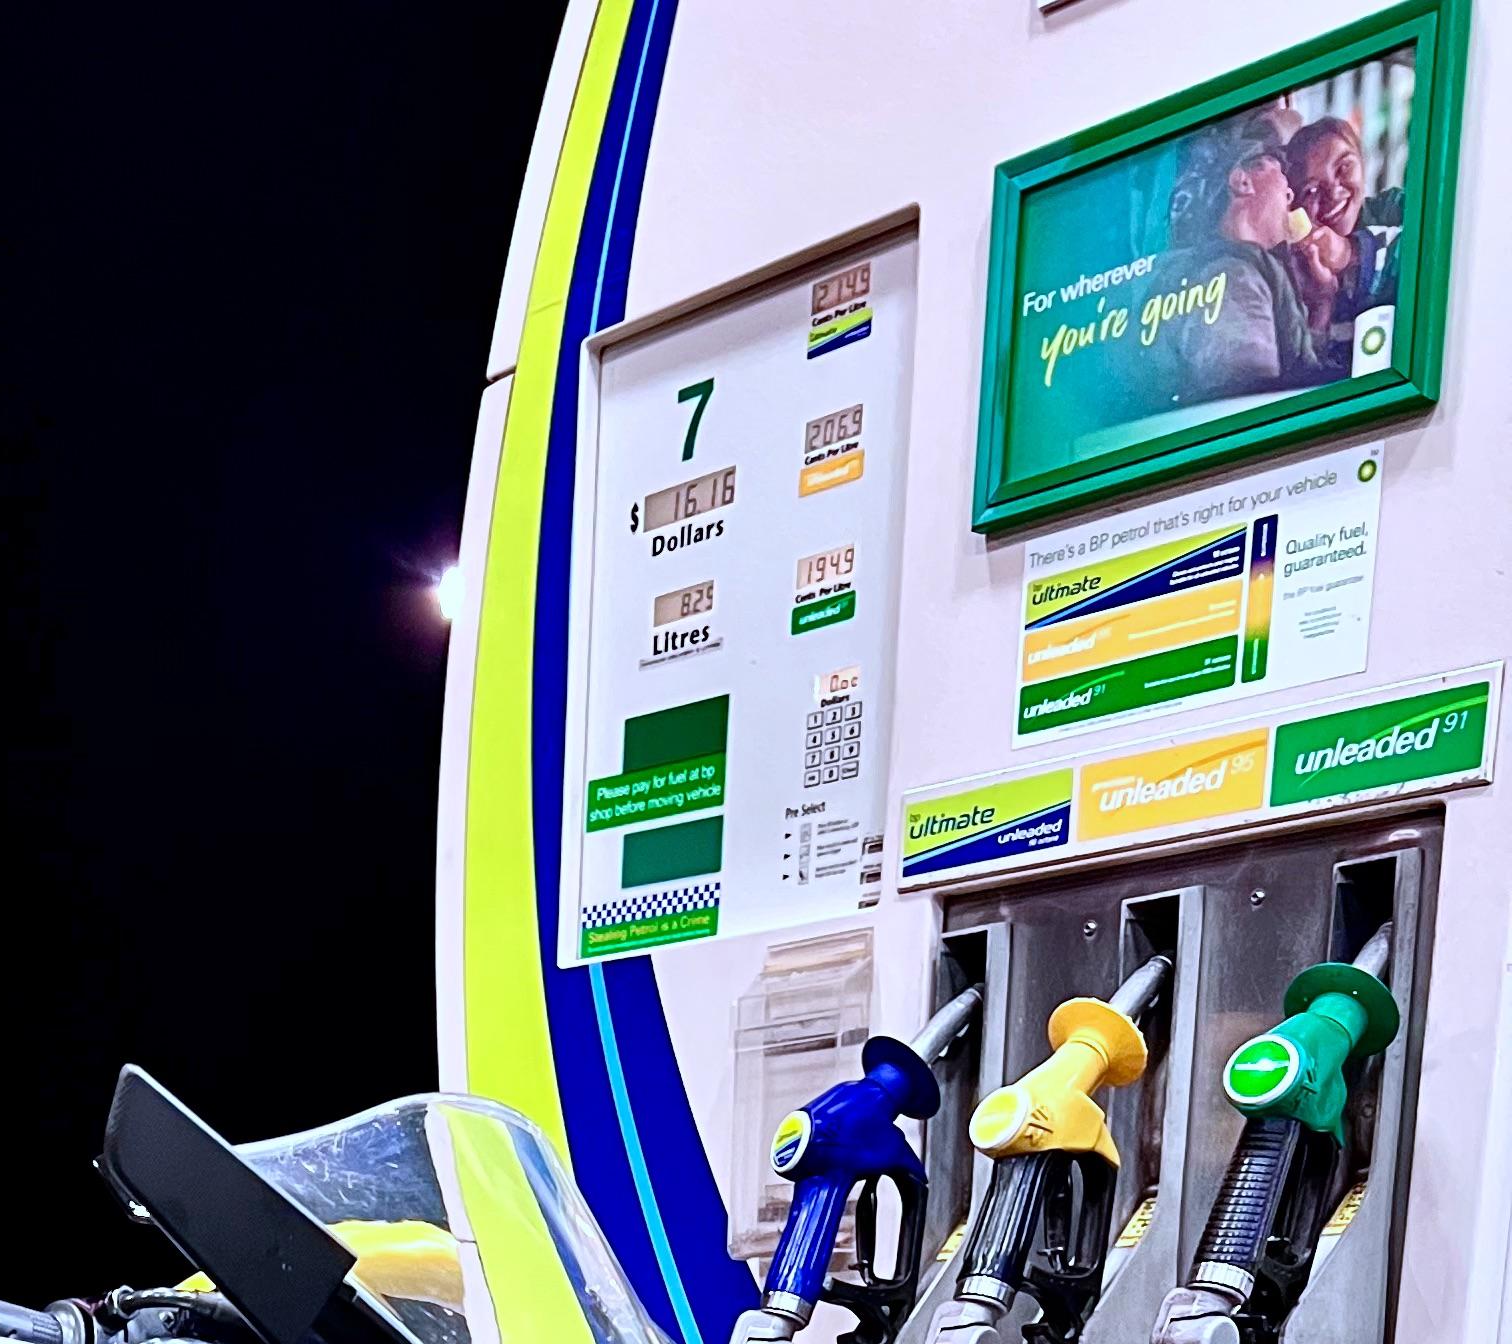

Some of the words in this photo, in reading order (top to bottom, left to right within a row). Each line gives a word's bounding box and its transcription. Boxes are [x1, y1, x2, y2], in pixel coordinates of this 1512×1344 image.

[1023, 290, 1057, 317] For
[1059, 254, 1157, 303] wherever
[1041, 296, 1128, 388] you're
[1140, 272, 1227, 346] going
[677, 377, 715, 463] 7
[630, 501, 639, 535] $
[1029, 541, 1075, 569] There's
[1077, 544, 1086, 557] a
[1089, 533, 1110, 552] BP
[1111, 521, 1151, 549] petrol
[1153, 511, 1189, 535] that's
[1192, 502, 1225, 525] right
[1228, 496, 1248, 513] for
[1250, 486, 1283, 511] your
[1285, 470, 1338, 497] vehicle
[652, 519, 724, 557] Dollars
[1285, 533, 1336, 555] Quality
[1339, 521, 1368, 542] fuel,
[1284, 540, 1367, 578] guaranteed.
[1032, 575, 1102, 606] ultimate
[653, 625, 710, 656] Litres
[1023, 687, 1093, 719] unleaded
[1093, 683, 1106, 697] 91
[1294, 717, 1440, 775] unleaded
[1443, 710, 1469, 733] 91
[596, 785, 630, 801] Please
[632, 781, 651, 796] pay
[653, 775, 667, 789] for
[668, 769, 687, 785] fuel
[689, 768, 700, 781] at
[701, 765, 715, 780] bp
[1099, 759, 1228, 813] unleaded
[1230, 751, 1257, 775] 95
[590, 808, 613, 822] shop
[614, 801, 646, 816] before
[648, 793, 685, 807] moving
[686, 784, 721, 801] vehicle
[785, 807, 799, 820] Pre
[801, 801, 826, 817] Select
[909, 805, 996, 840] ultimate
[997, 818, 1063, 844] unleaded
[629, 922, 658, 937] Petrol
[680, 915, 710, 929] Crime
